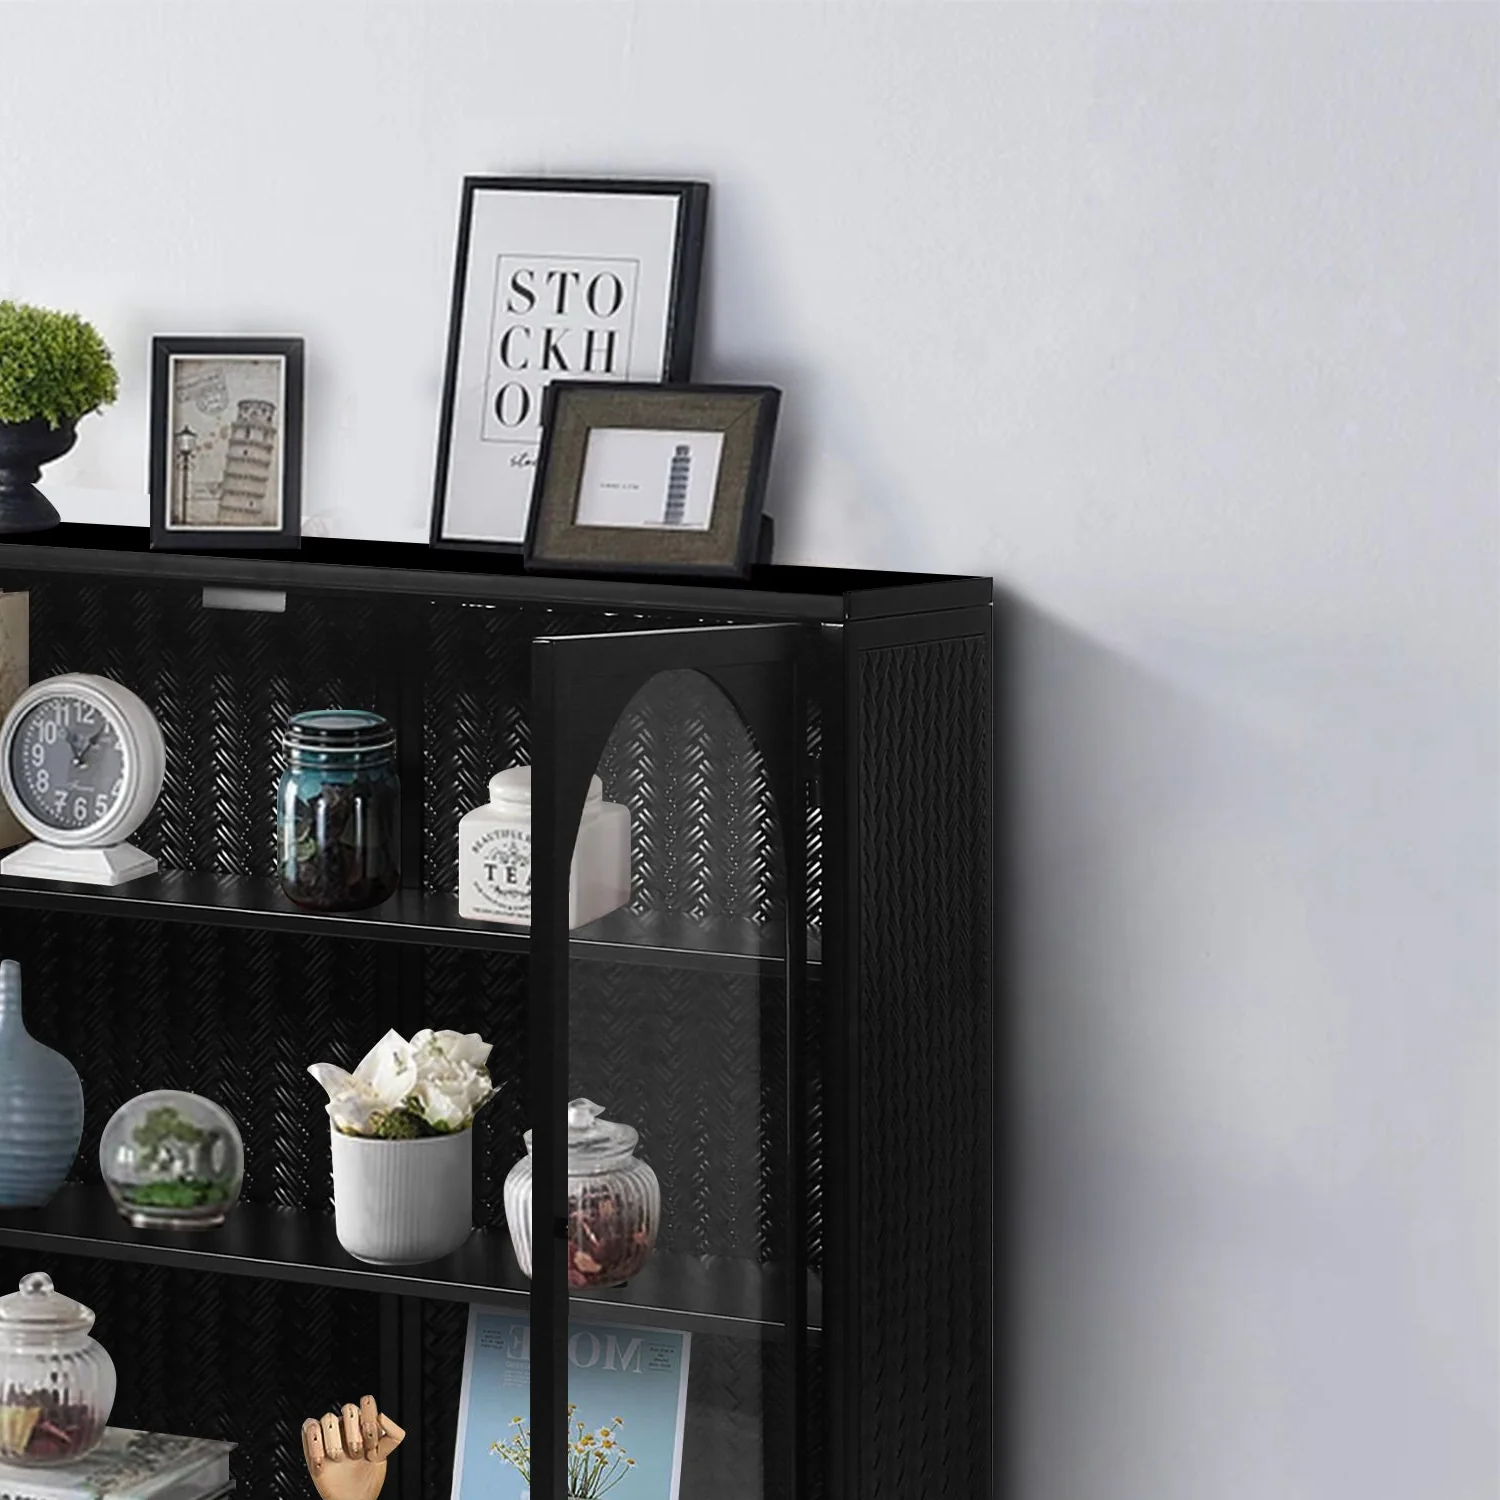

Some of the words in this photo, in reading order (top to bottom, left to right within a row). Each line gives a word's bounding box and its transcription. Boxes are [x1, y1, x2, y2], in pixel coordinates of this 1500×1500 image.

[506, 268, 624, 319] STO
[499, 325, 619, 374] CKH
[54, 702, 70, 726] 11
[73, 702, 95, 724] 12
[39, 720, 57, 744] 10
[32, 743, 45, 767] 9
[36, 769, 50, 793] 8
[54, 791, 69, 813] 7
[73, 797, 88, 820] 6
[95, 794, 109, 817] 5
